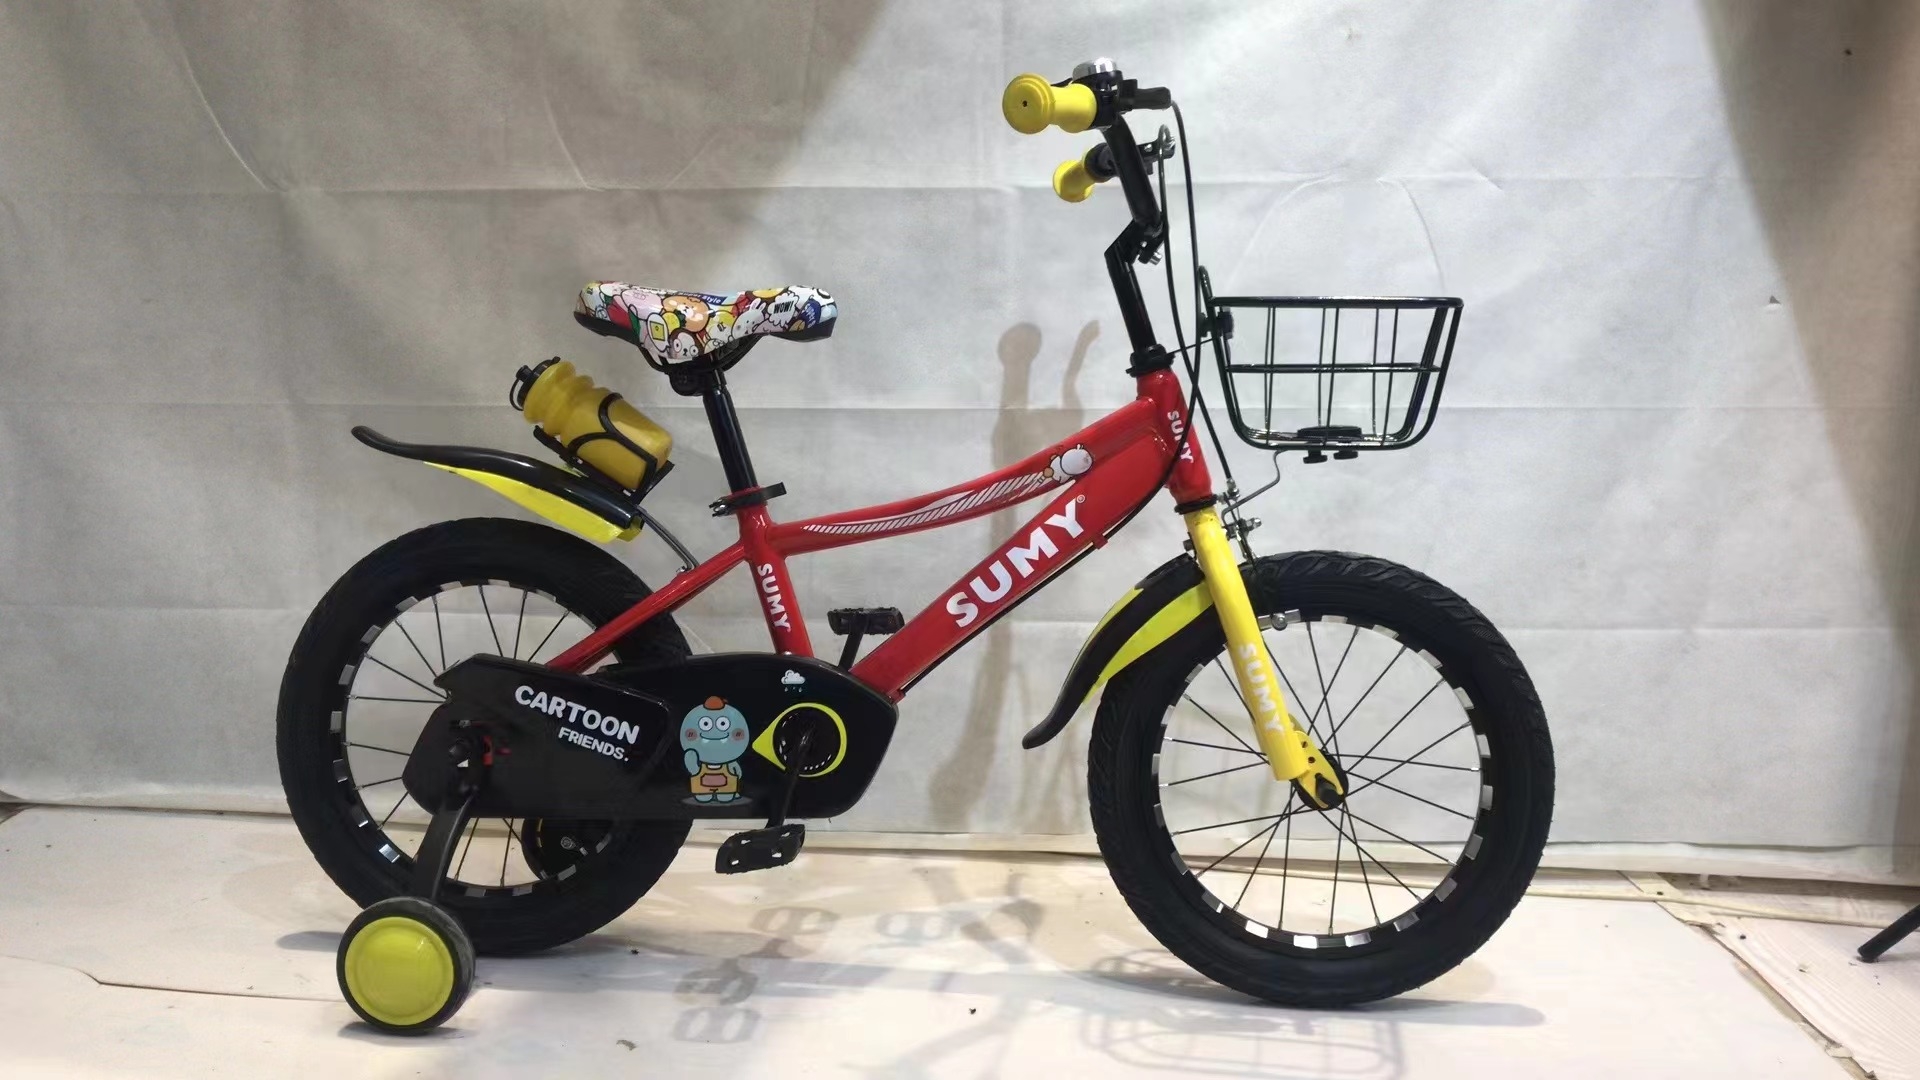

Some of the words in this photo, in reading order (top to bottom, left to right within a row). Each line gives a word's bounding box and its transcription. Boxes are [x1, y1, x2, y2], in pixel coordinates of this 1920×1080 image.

[773, 300, 795, 314] WOW!
[757, 563, 792, 633] SUMY
[514, 685, 640, 745] CARTOON
[1238, 643, 1285, 734] SUMY
[558, 726, 629, 762] FRIENDS.
